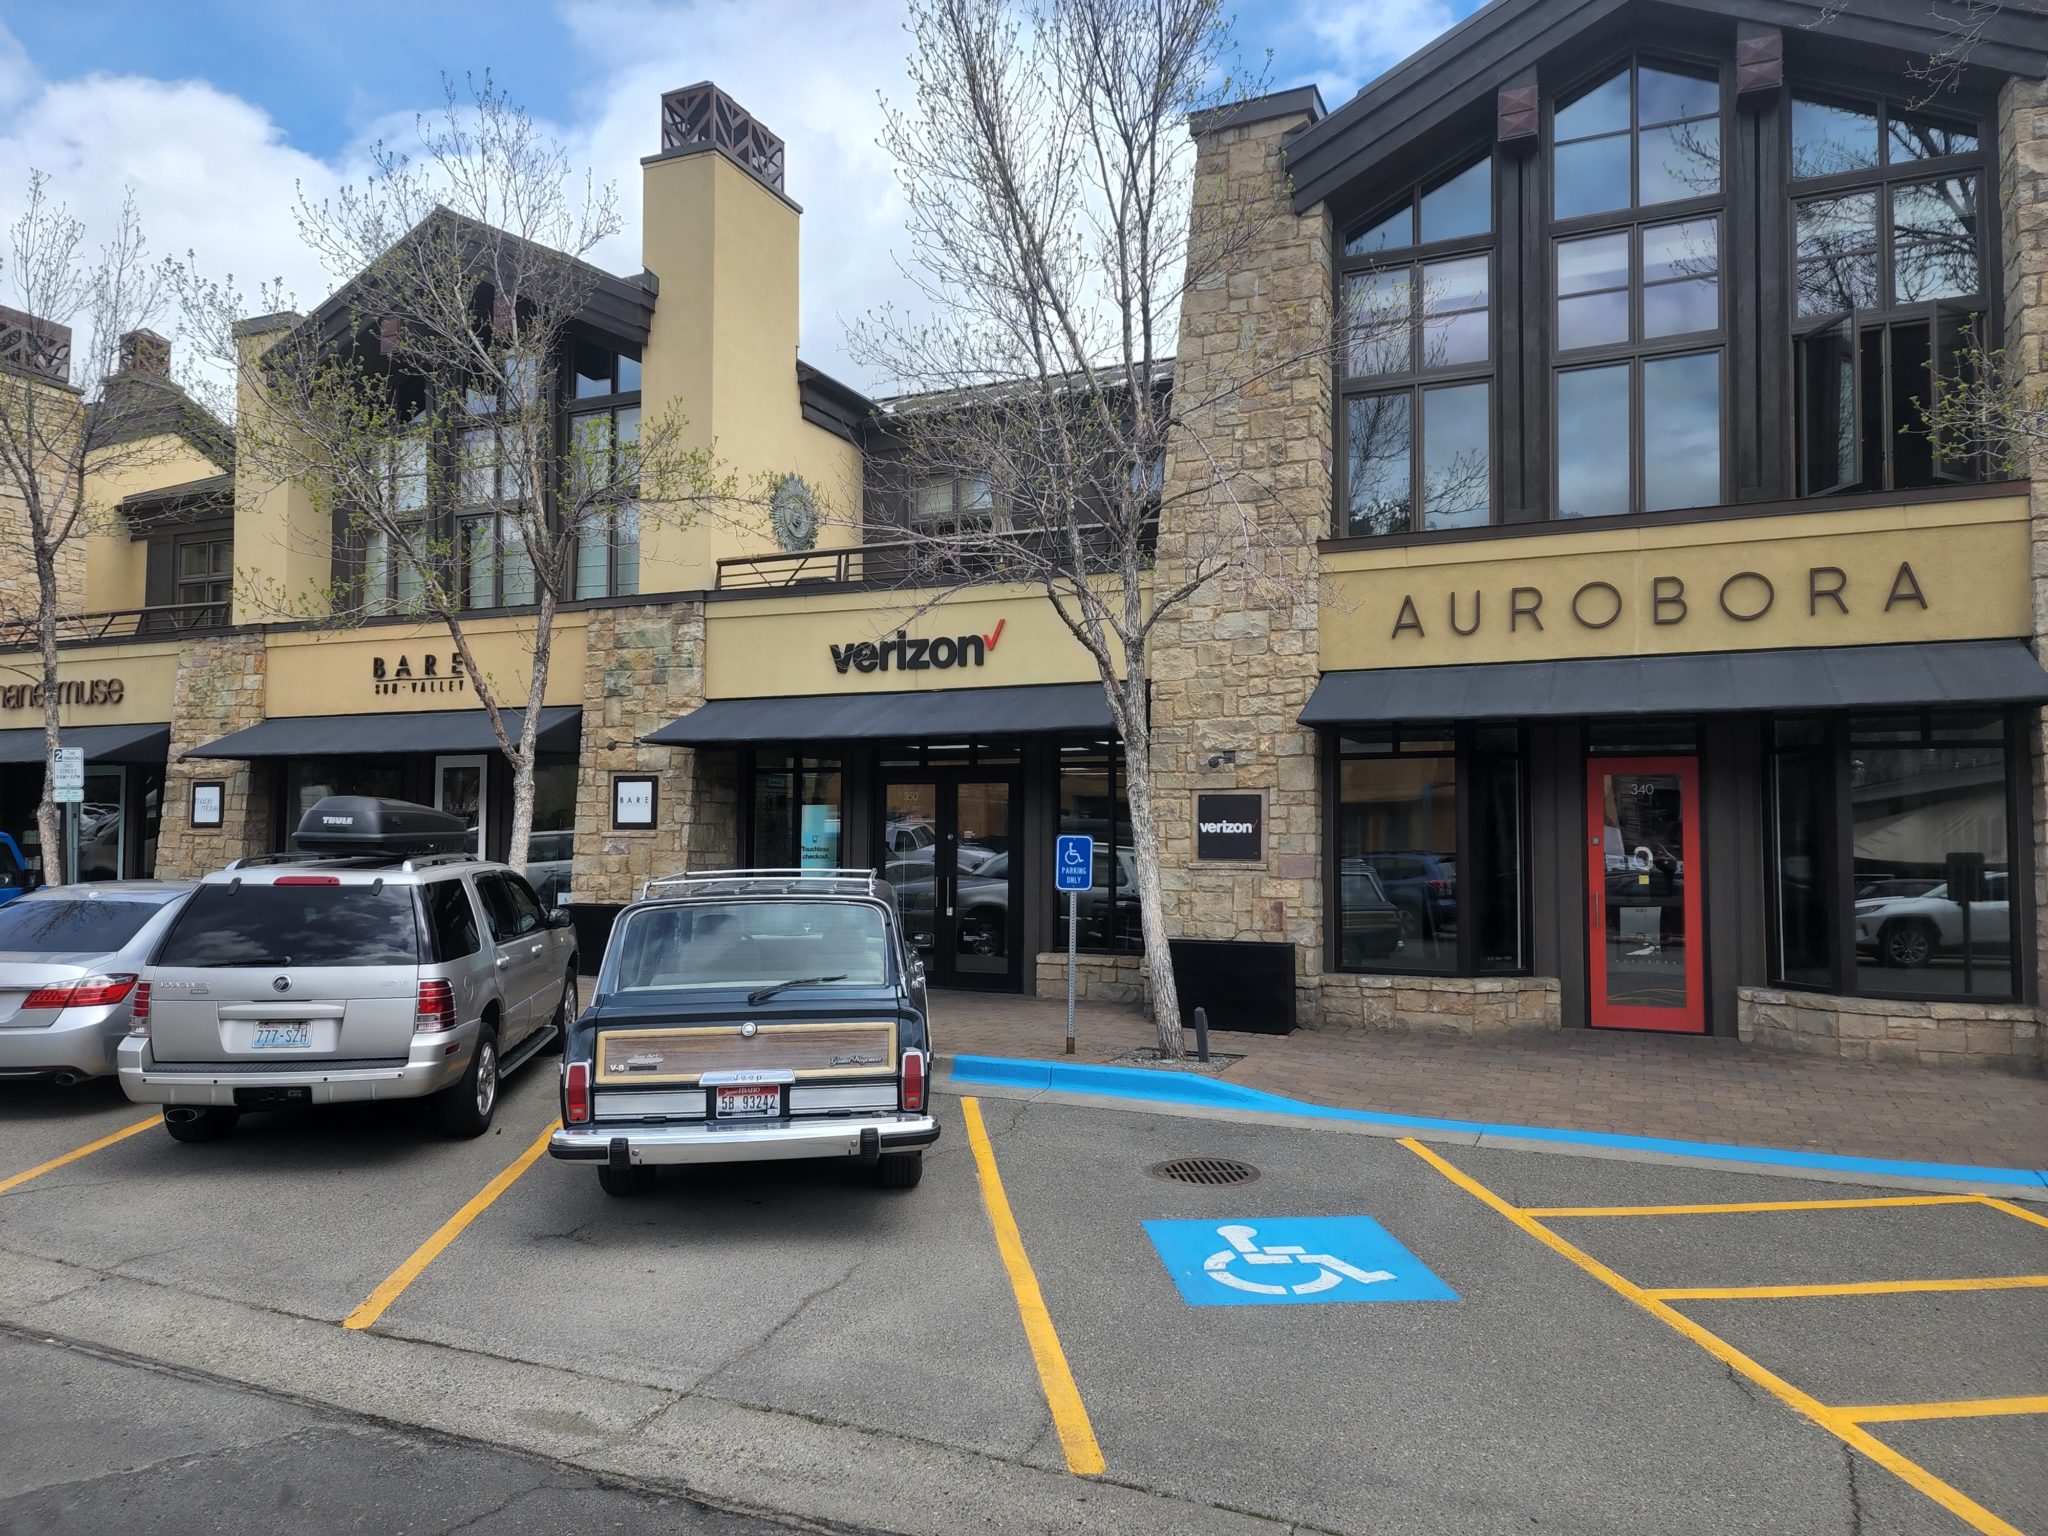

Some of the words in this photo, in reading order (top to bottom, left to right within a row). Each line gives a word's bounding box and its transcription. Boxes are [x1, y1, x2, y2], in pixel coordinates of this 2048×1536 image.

[1391, 561, 1929, 639] AUROBORA
[829, 629, 985, 674] verizon
[373, 652, 464, 679] BARE
[57, 678, 125, 705] muse
[55, 751, 62, 761] 2
[1631, 783, 1654, 795] 340
[619, 796, 649, 804] BARE
[322, 816, 353, 825] THULE
[1199, 819, 1253, 834] verizon
[1061, 866, 1087, 875] PARKING
[1066, 876, 1082, 884] ONLY
[257, 1029, 308, 1044] 777-SZH
[610, 1064, 625, 1072] V-8
[732, 1074, 763, 1082] Jeep
[721, 1096, 735, 1110] 5B
[742, 1094, 777, 1110] 93242
